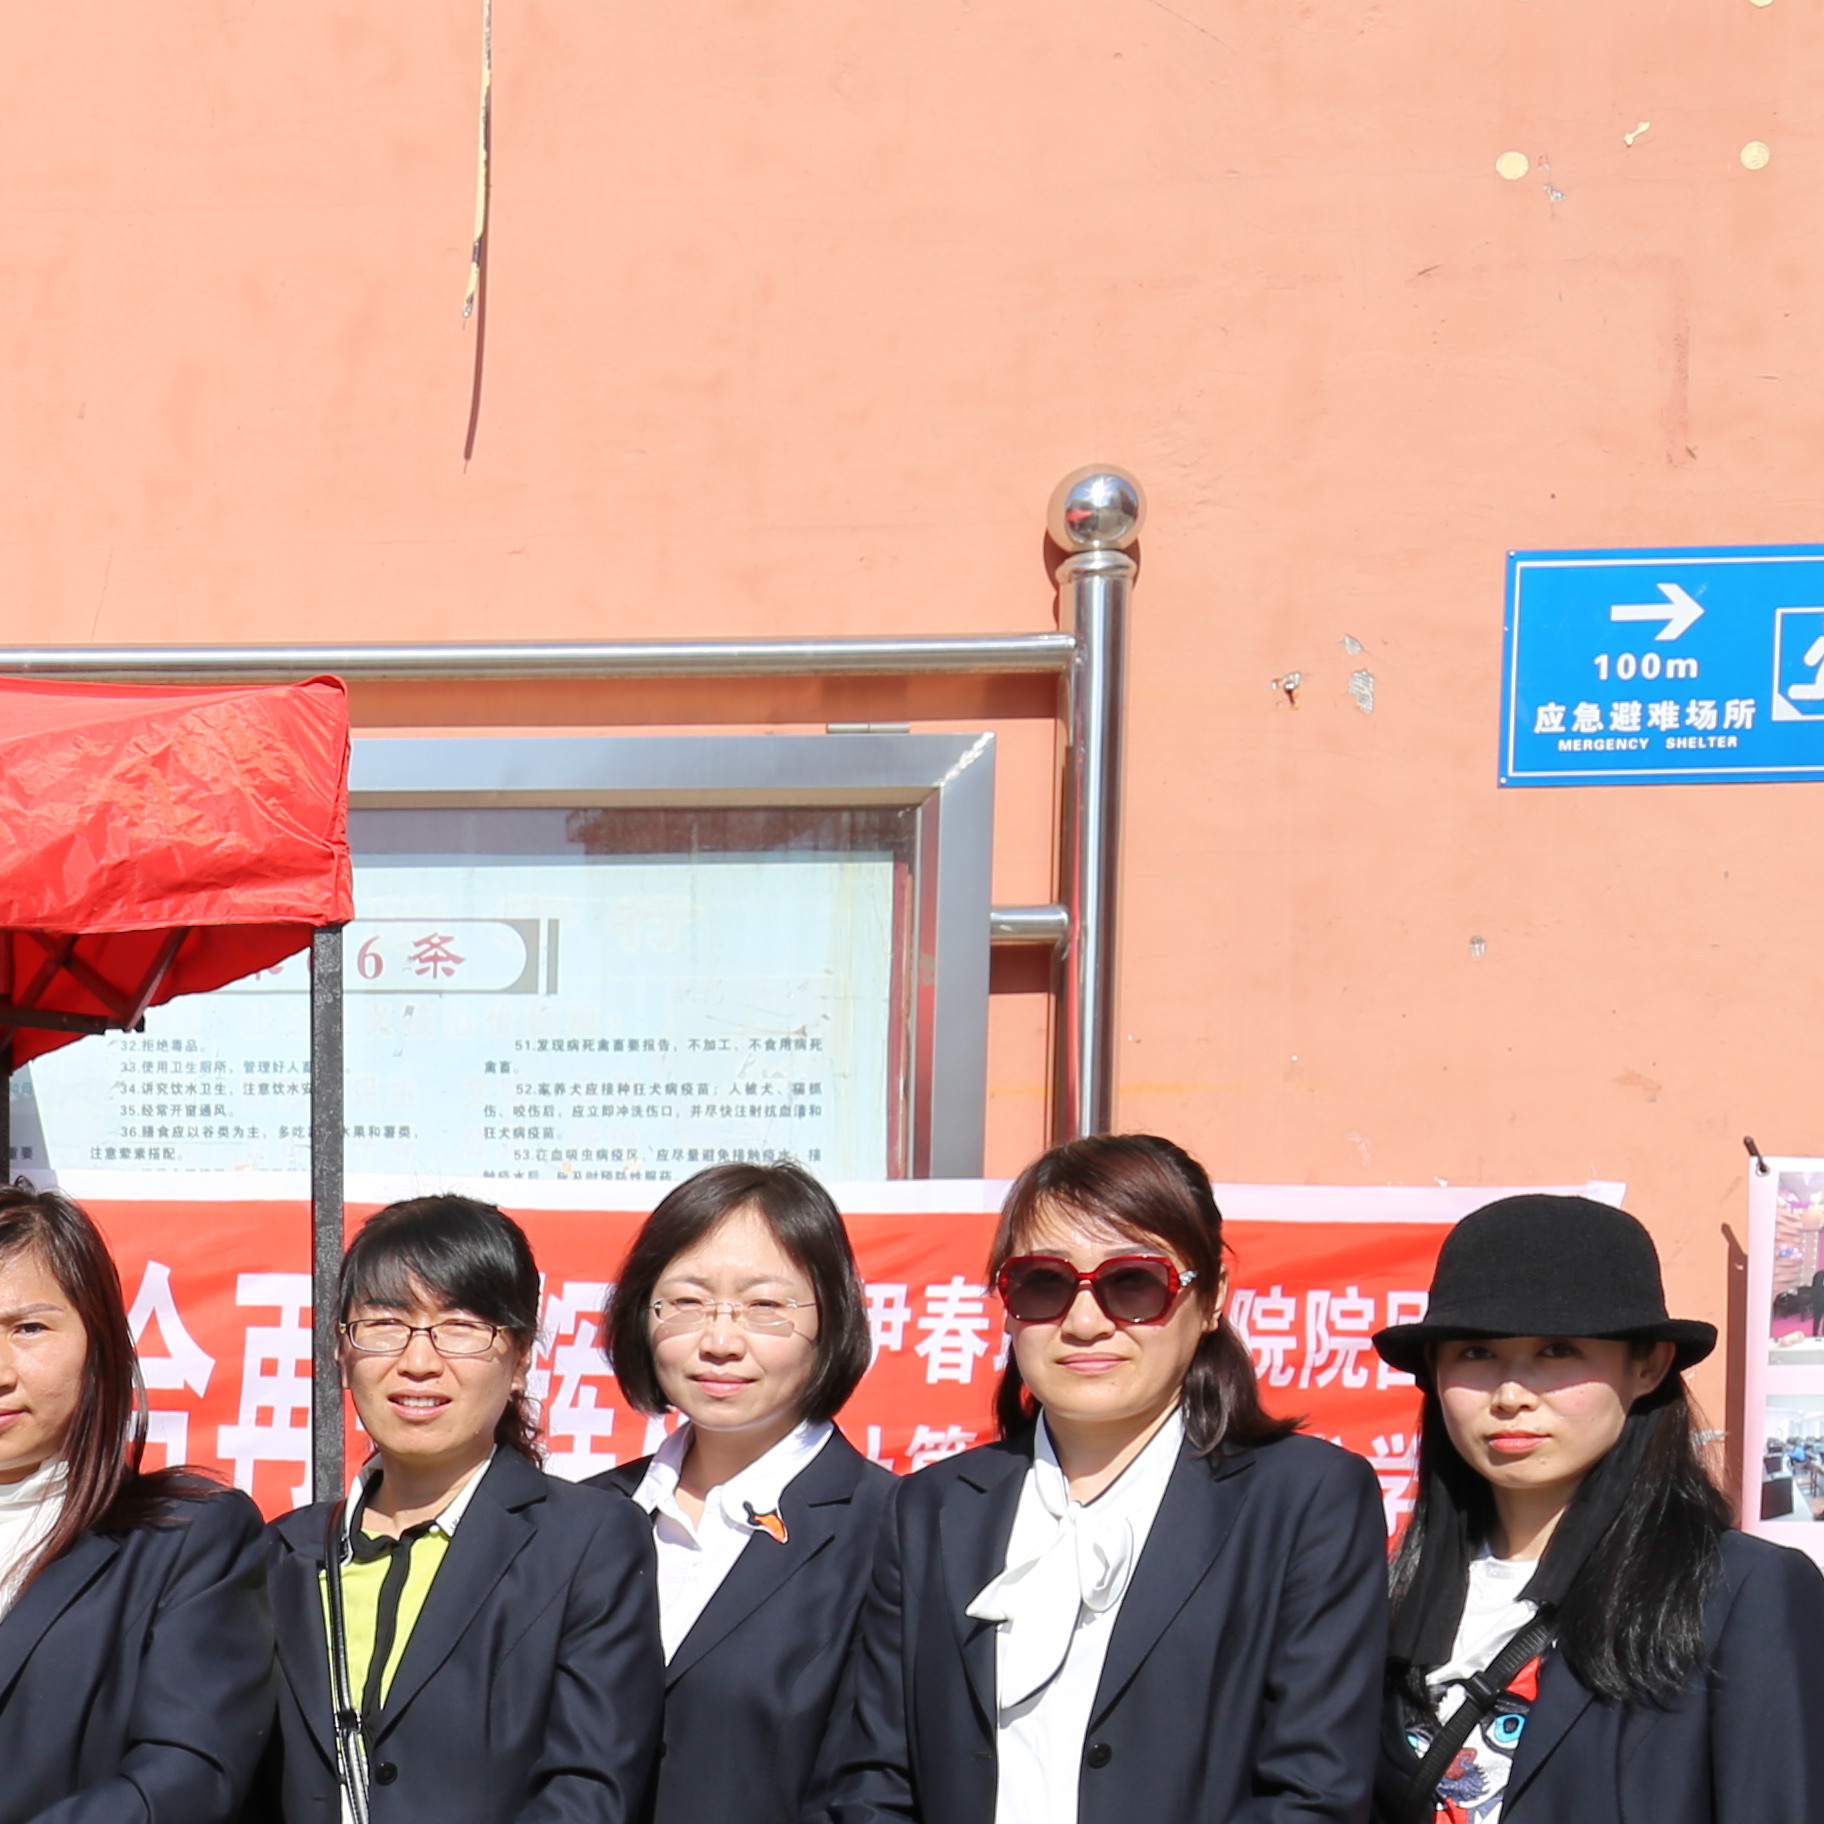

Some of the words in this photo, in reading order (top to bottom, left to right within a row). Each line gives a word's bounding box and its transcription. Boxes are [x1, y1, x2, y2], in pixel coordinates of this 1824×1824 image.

[1593, 653, 1699, 680] 100m
[1533, 698, 1757, 734] 应急避难场所
[1558, 737, 1649, 752] MERGENCY
[1665, 735, 1738, 750] SHELTER
[120, 1060, 351, 1075] 33.使用卫生厕所，管理好人畜。
